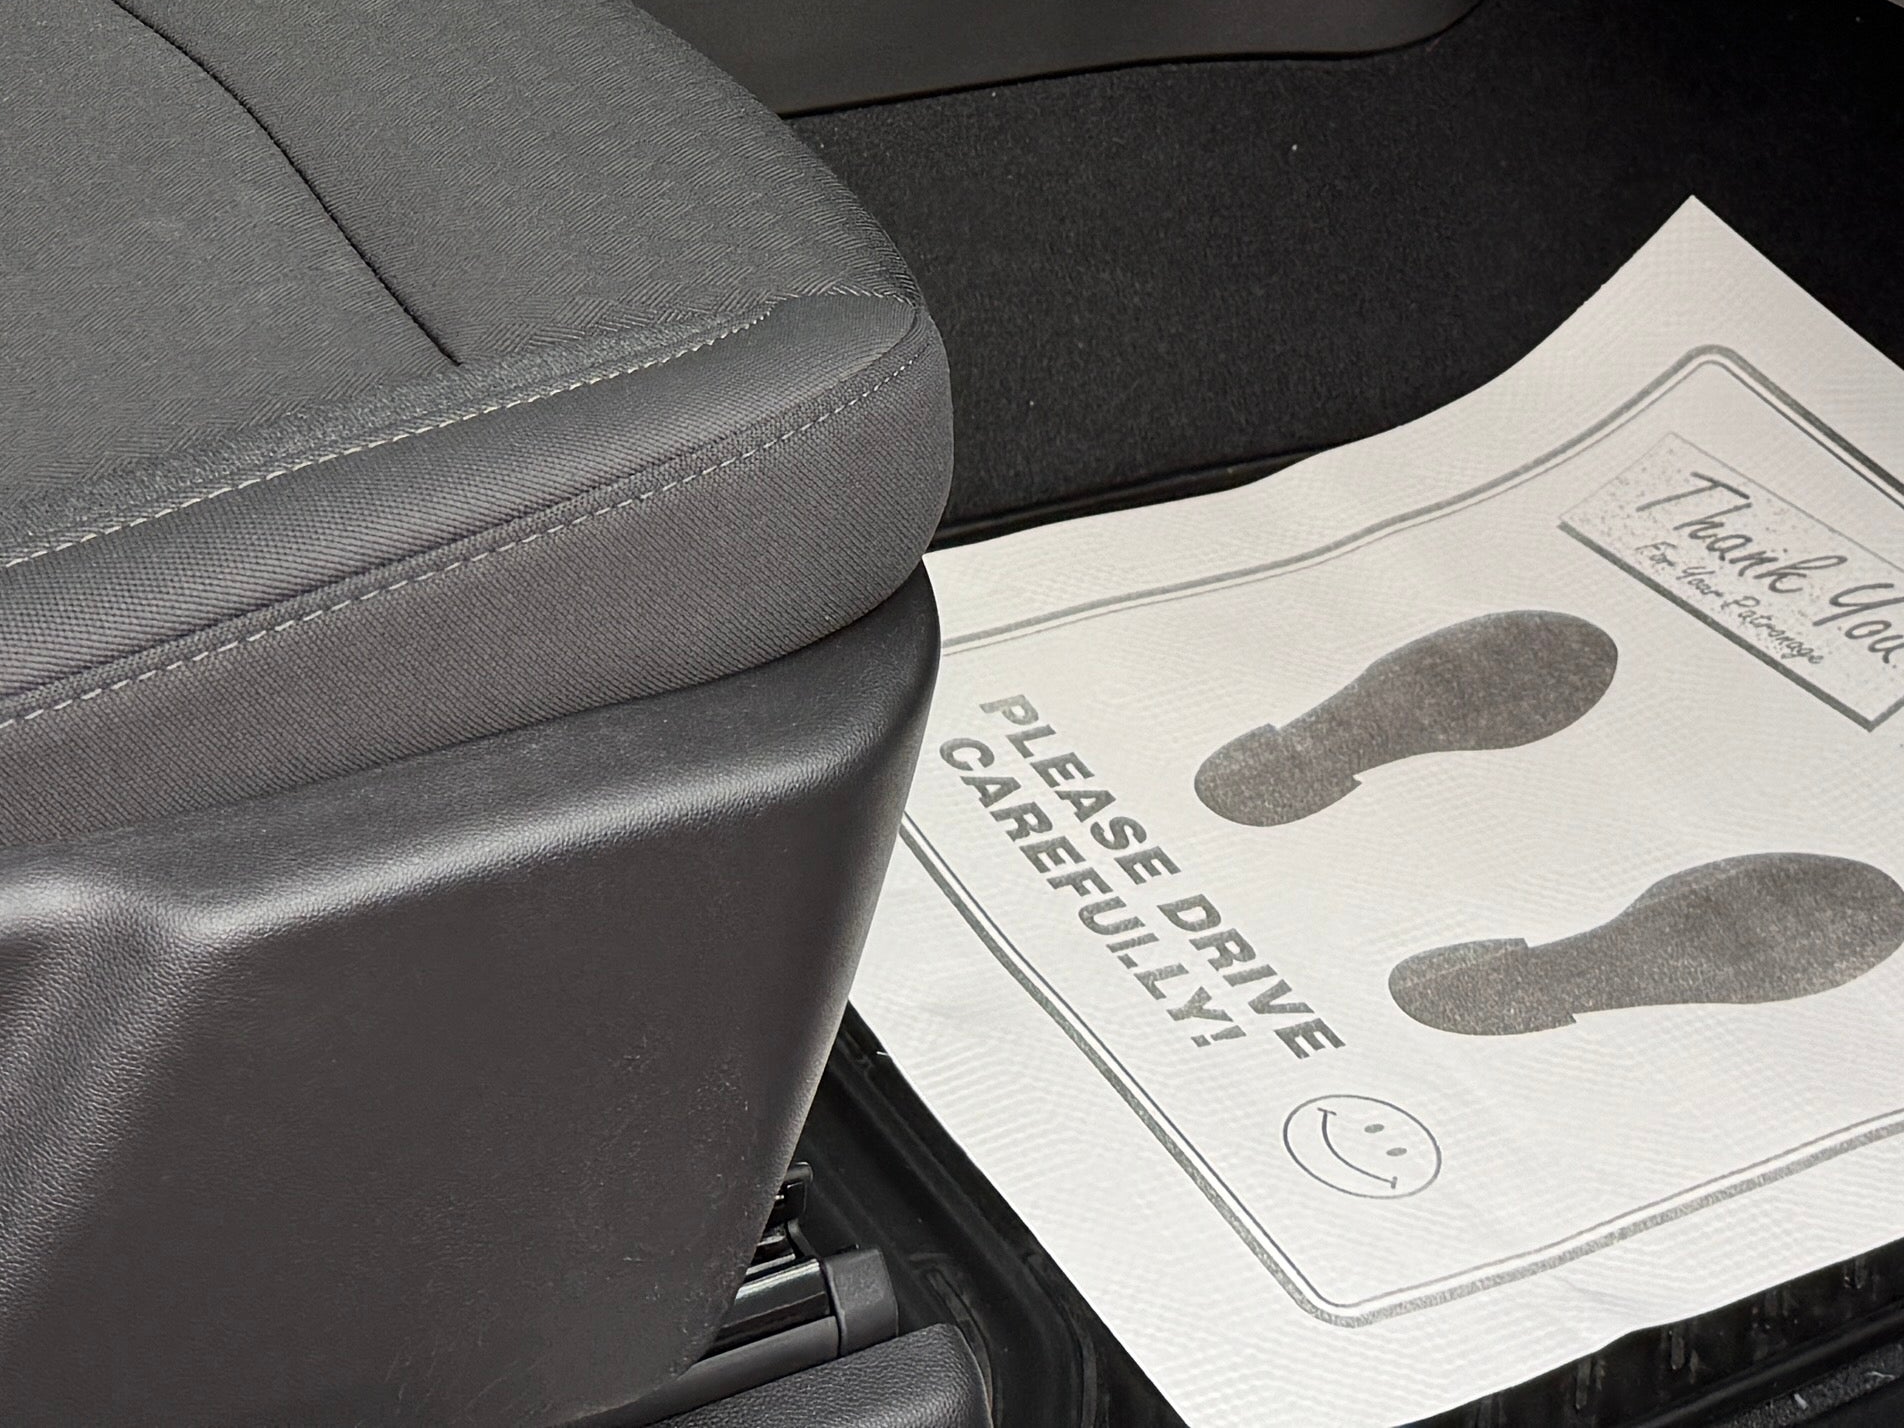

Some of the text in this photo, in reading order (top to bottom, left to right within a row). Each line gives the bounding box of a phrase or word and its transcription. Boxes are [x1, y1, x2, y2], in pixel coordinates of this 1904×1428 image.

[1636, 472, 1848, 594] Thank
[1636, 541, 1824, 665] For Your Patronage
[939, 737, 1247, 1048] CAREFULLY!
[979, 694, 1346, 1060] PLEASE DRIVE
